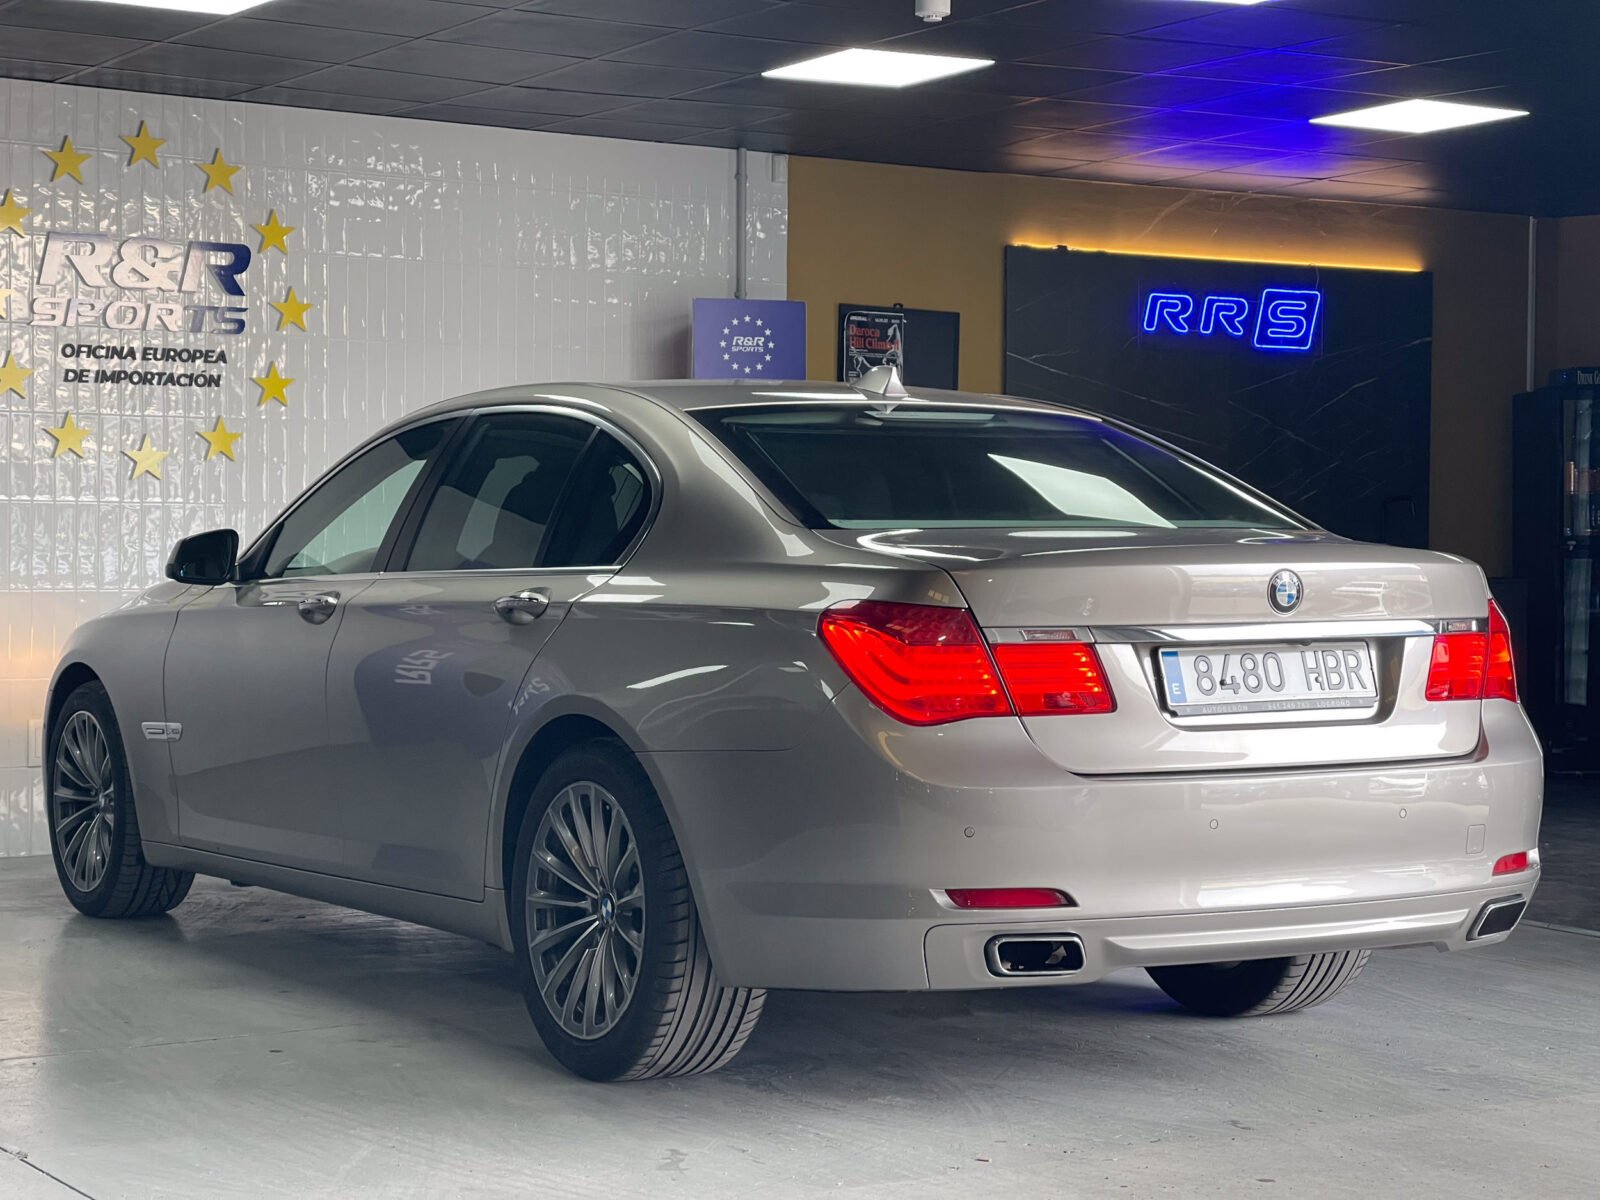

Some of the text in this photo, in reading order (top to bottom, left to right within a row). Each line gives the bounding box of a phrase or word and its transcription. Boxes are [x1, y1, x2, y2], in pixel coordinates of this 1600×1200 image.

[37, 231, 251, 296] R&R
[28, 297, 249, 335] SPORTS
[1144, 292, 1308, 339] RRS
[732, 336, 765, 346] R&R
[849, 324, 880, 337] Daroca
[61, 343, 228, 364] OFICINA EUROPEA
[63, 369, 222, 388] DE IMPORTACIÓN
[1193, 649, 1368, 697] 8480 HBR
[1172, 683, 1182, 695] E
